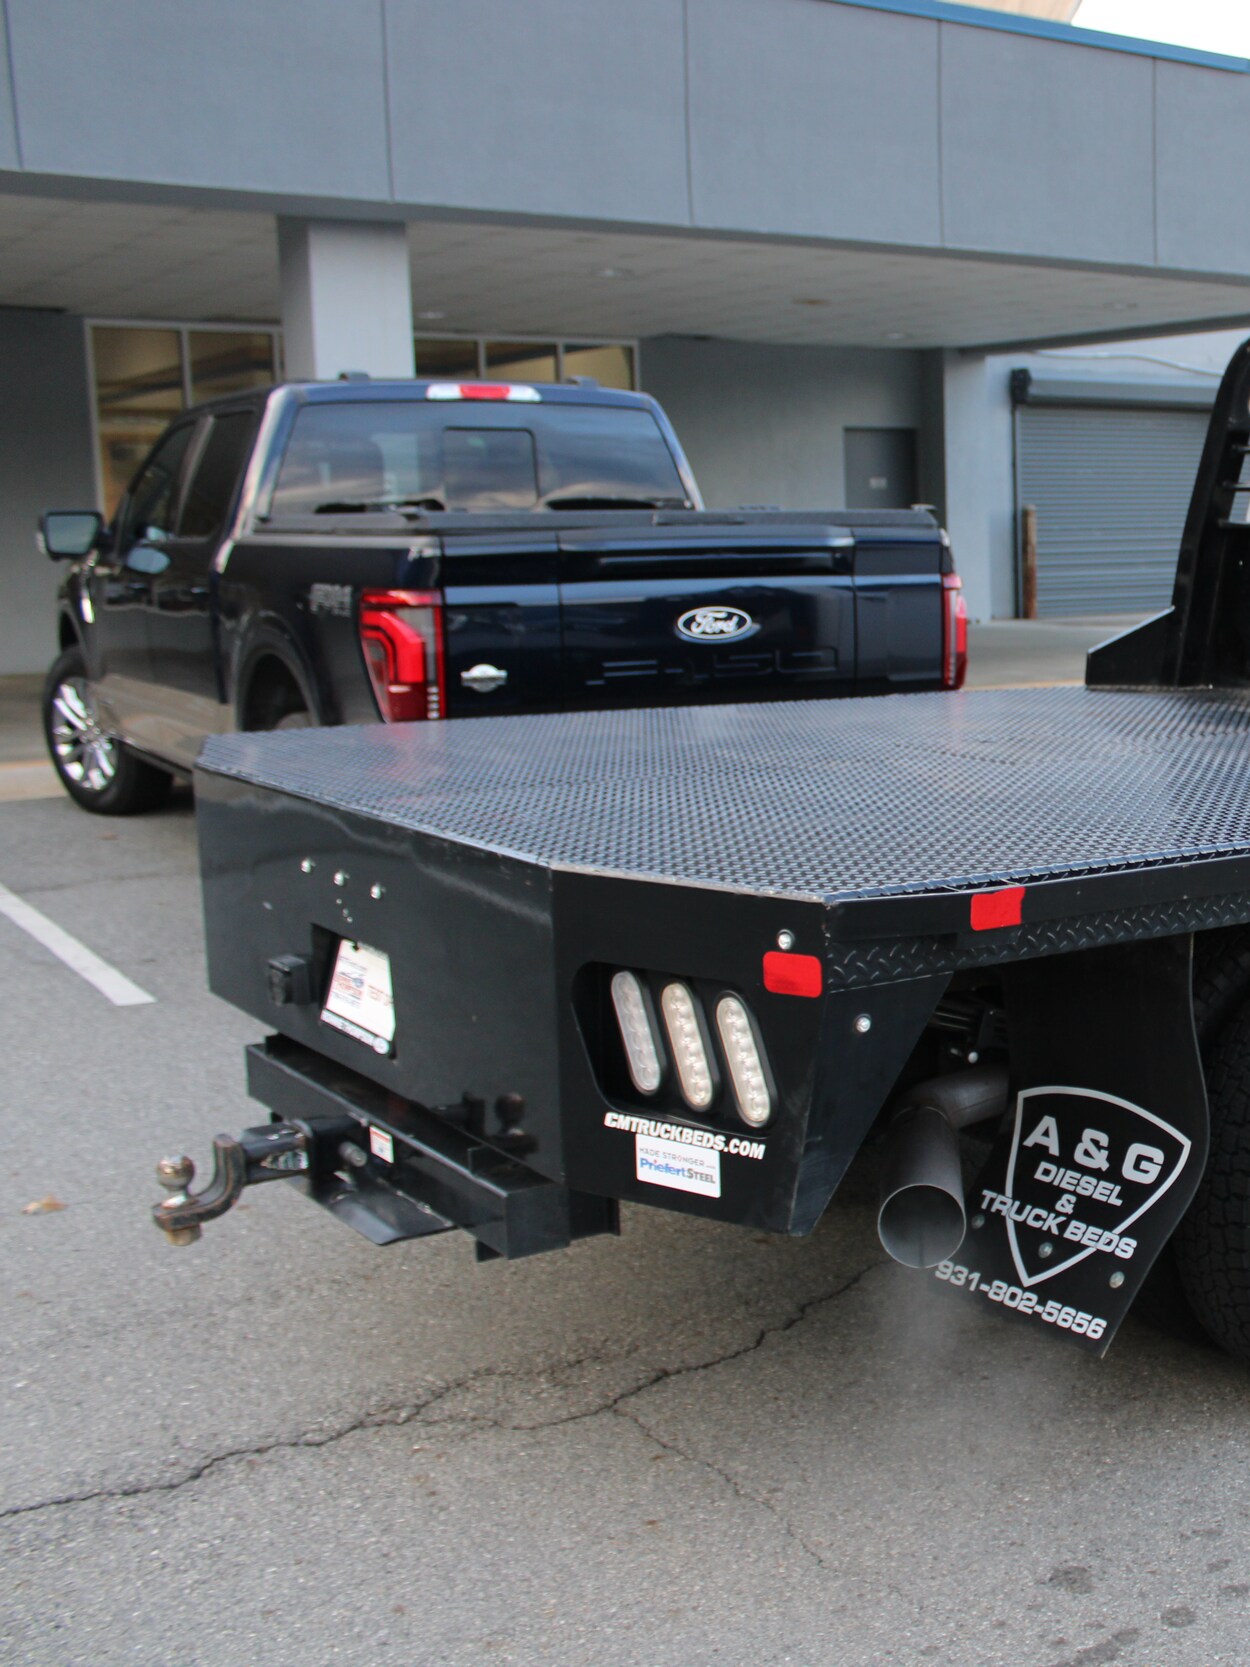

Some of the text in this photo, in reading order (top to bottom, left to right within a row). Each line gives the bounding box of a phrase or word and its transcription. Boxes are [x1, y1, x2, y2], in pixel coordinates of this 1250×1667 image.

[690, 610, 740, 634] Ford
[604, 1111, 766, 1160] CMTRUCKBEDS.COM
[639, 1146, 705, 1168] MADE STRONGER
[1023, 1115, 1165, 1185] A & G
[1033, 1161, 1123, 1207] DIESEL
[1054, 1194, 1077, 1215] &
[980, 1189, 1138, 1260] TRUCK BEDS
[934, 1260, 1108, 1340] 931-802-5656
